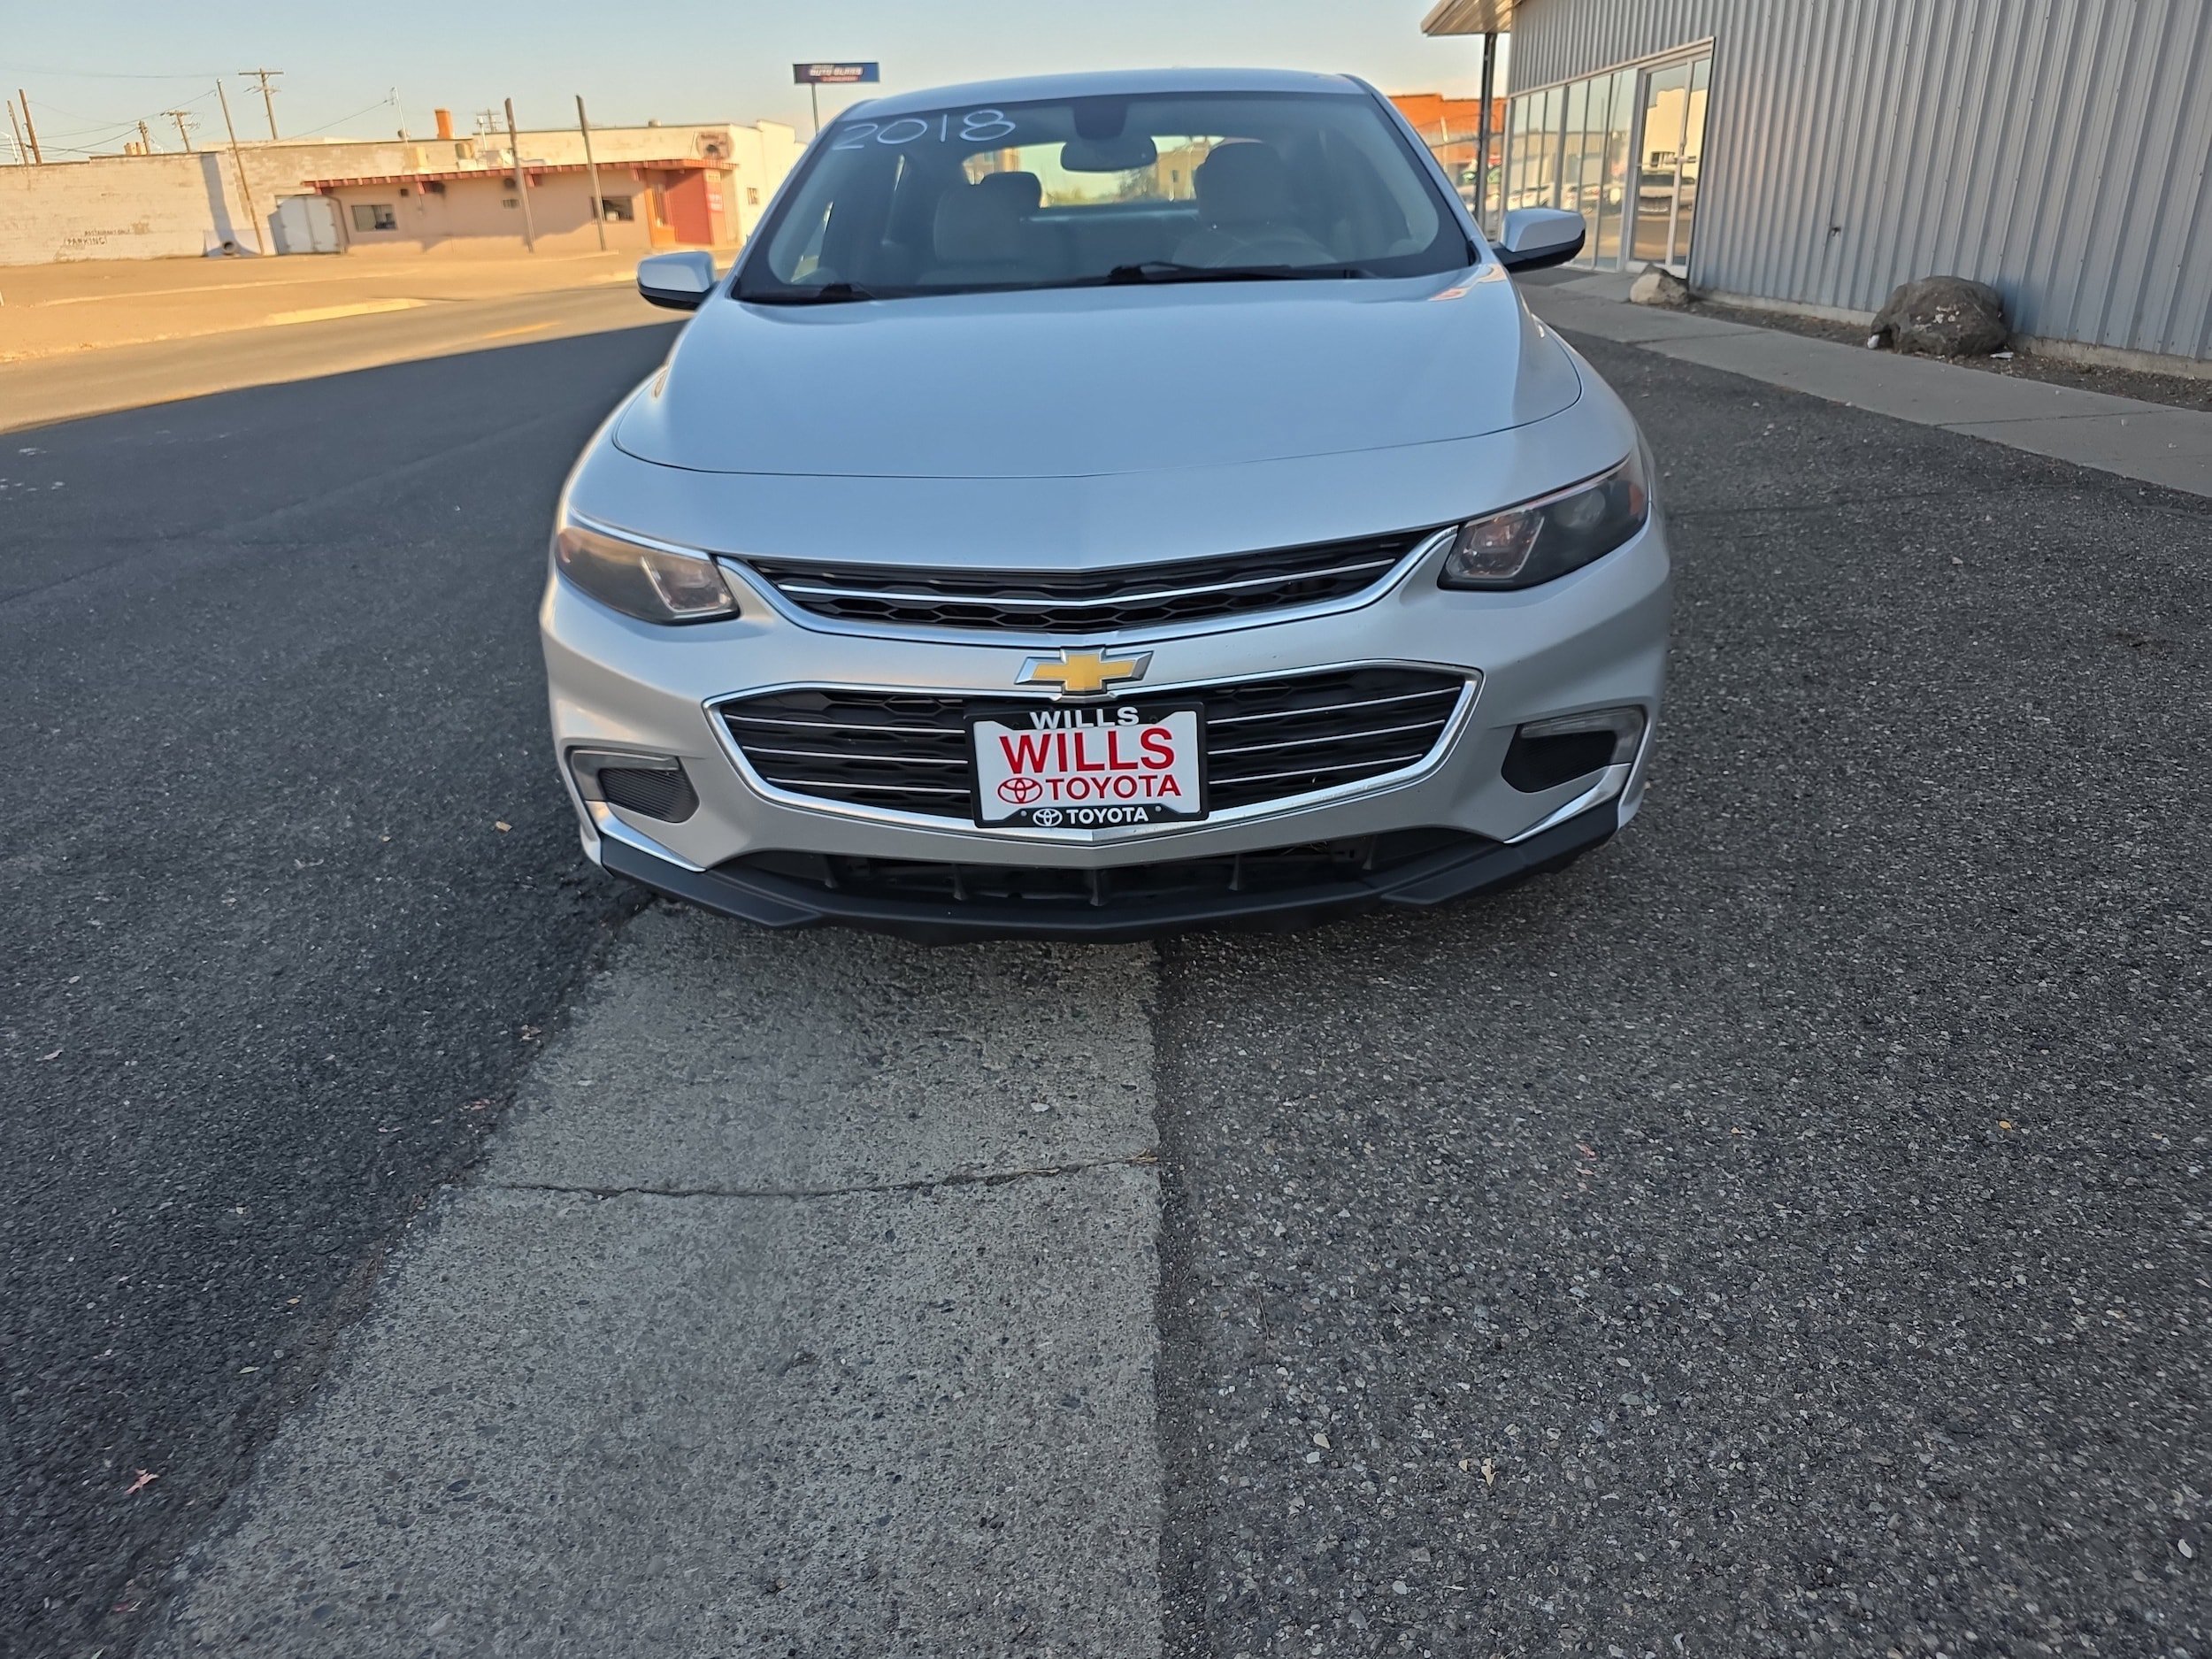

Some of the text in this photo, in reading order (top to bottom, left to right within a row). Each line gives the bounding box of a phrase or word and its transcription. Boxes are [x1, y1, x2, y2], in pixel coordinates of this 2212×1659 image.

[832, 109, 1017, 150] 2018
[1029, 706, 1140, 730] WILLS
[998, 727, 1176, 775] WILLS
[1045, 774, 1182, 801] TOYOTA
[1066, 806, 1149, 825] TOYOTA
